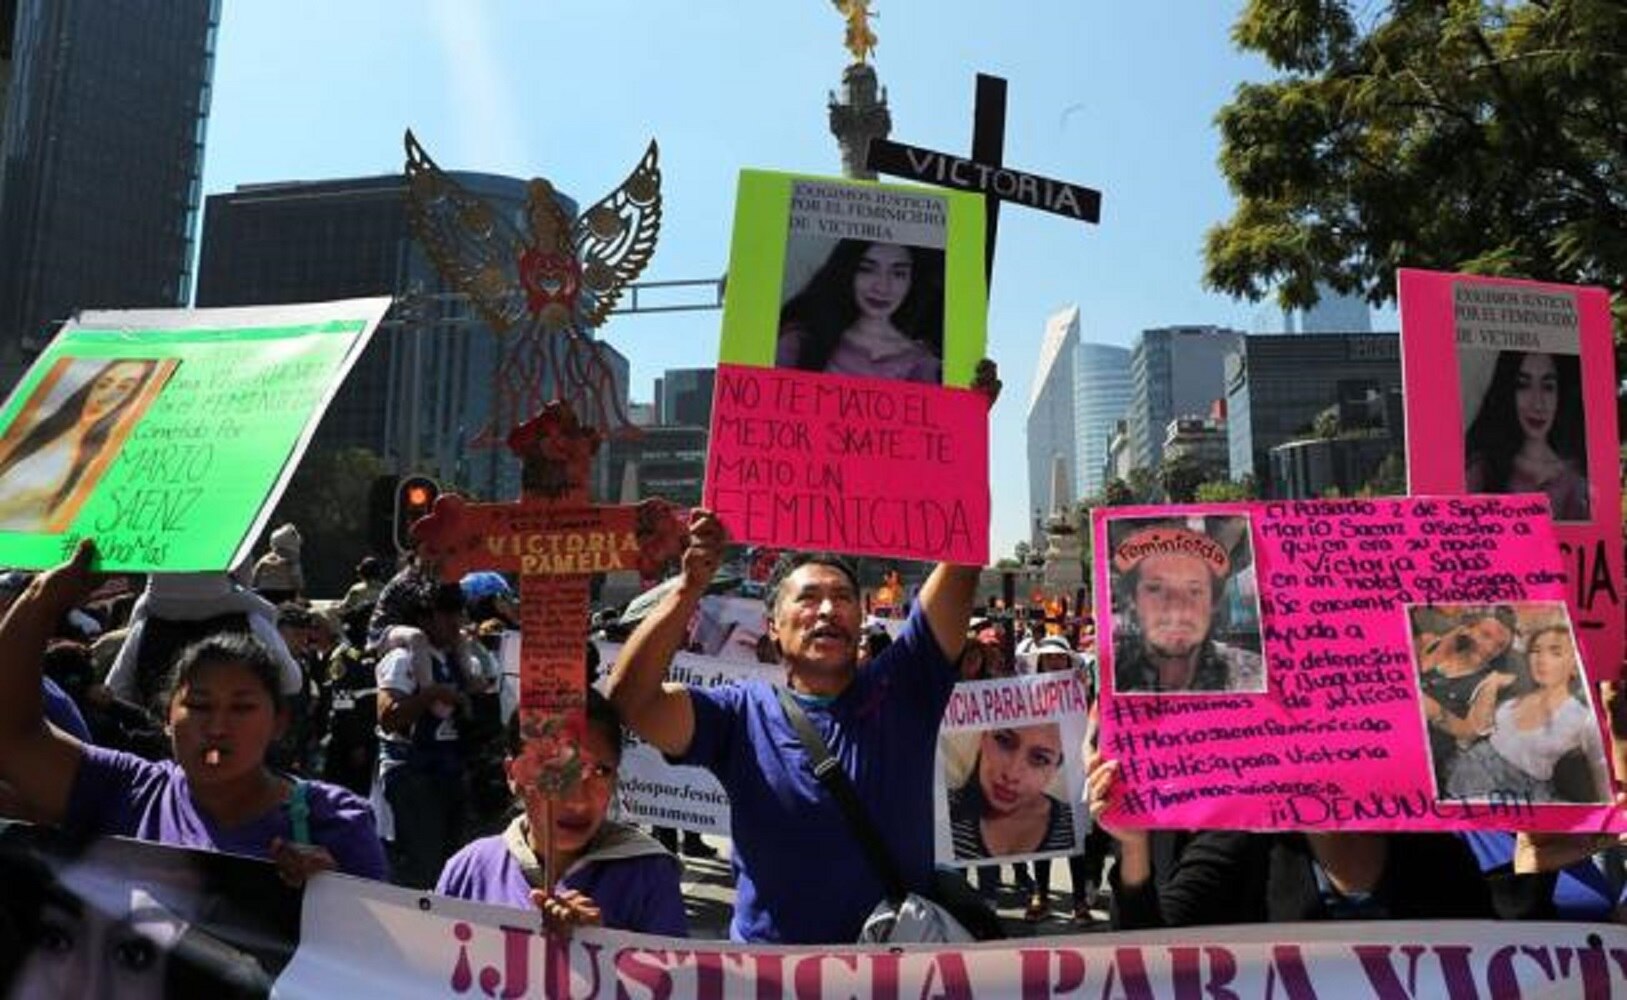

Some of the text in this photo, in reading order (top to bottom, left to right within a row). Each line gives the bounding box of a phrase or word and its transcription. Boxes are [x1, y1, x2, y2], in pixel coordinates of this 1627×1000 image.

[906, 148, 1081, 216] VICTORIA
[792, 196, 820, 211] POR
[824, 200, 840, 213] EL
[875, 192, 942, 211] JUSTICIA
[819, 219, 893, 239] VICTORIA
[1480, 329, 1541, 348] VICTORIA
[718, 375, 940, 429] NO TE MATO EL
[716, 414, 812, 452] MEJOR
[925, 433, 953, 464] TE
[119, 443, 215, 483] MARIO
[714, 456, 794, 484] MATO
[806, 466, 843, 494] UN
[93, 486, 205, 535] SAENZ
[712, 489, 974, 552] FEMINICIDA
[1413, 502, 1438, 517] de
[1261, 518, 1332, 538] Mario
[1512, 522, 1531, 536] a
[485, 531, 641, 553] VICTORIA
[1281, 533, 1348, 564] quien
[520, 552, 624, 575] PAMELA
[1302, 551, 1416, 574] Victoria
[1344, 624, 1365, 640] a
[983, 684, 1026, 722] PARA
[1029, 678, 1086, 717] LUPITA
[1018, 945, 1324, 1000] PARA
